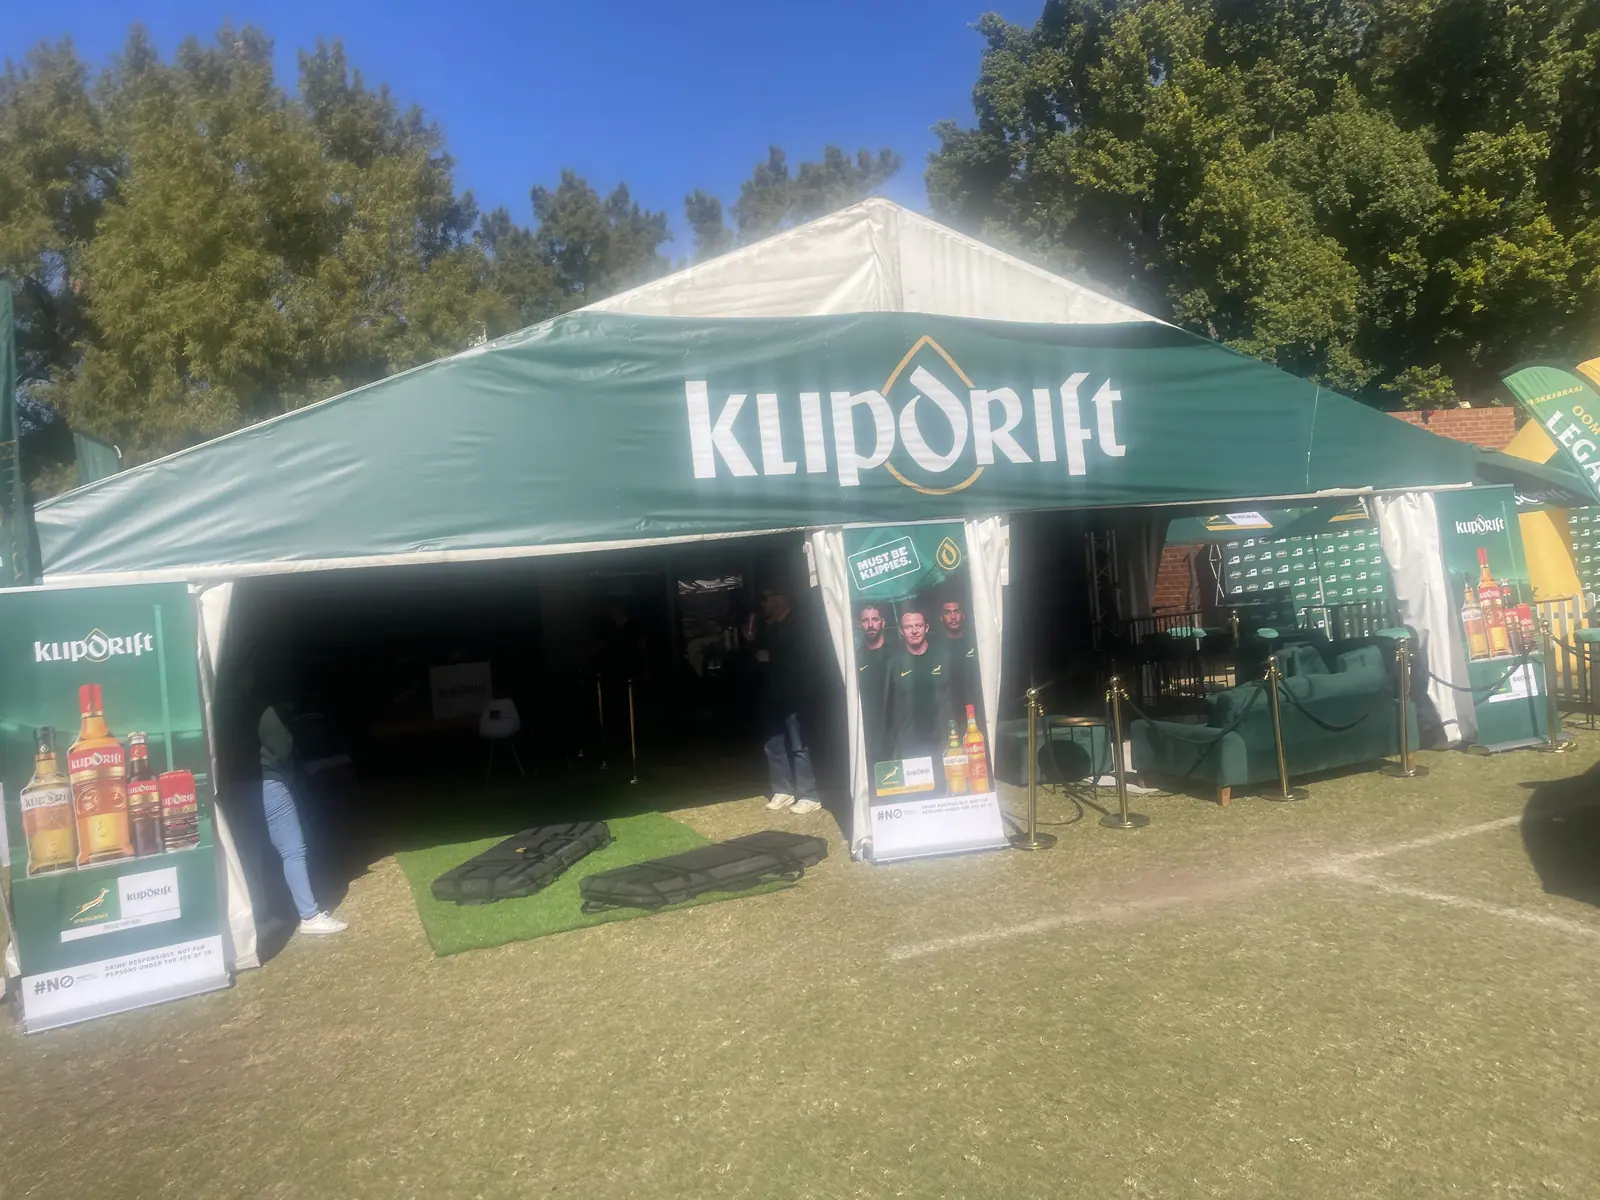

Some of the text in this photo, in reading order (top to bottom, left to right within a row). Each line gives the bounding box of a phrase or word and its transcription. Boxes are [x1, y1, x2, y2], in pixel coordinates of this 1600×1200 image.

[1571, 405, 1600, 436] OOM
[1545, 409, 1600, 495] LEGA
[856, 546, 908, 571] MUST BE
[860, 556, 912, 580] KLIPPIES.
[105, 967, 137, 977] PERSONS
[140, 961, 162, 970] UNDER
[165, 957, 177, 965] THE
[105, 963, 126, 972] DRINK
